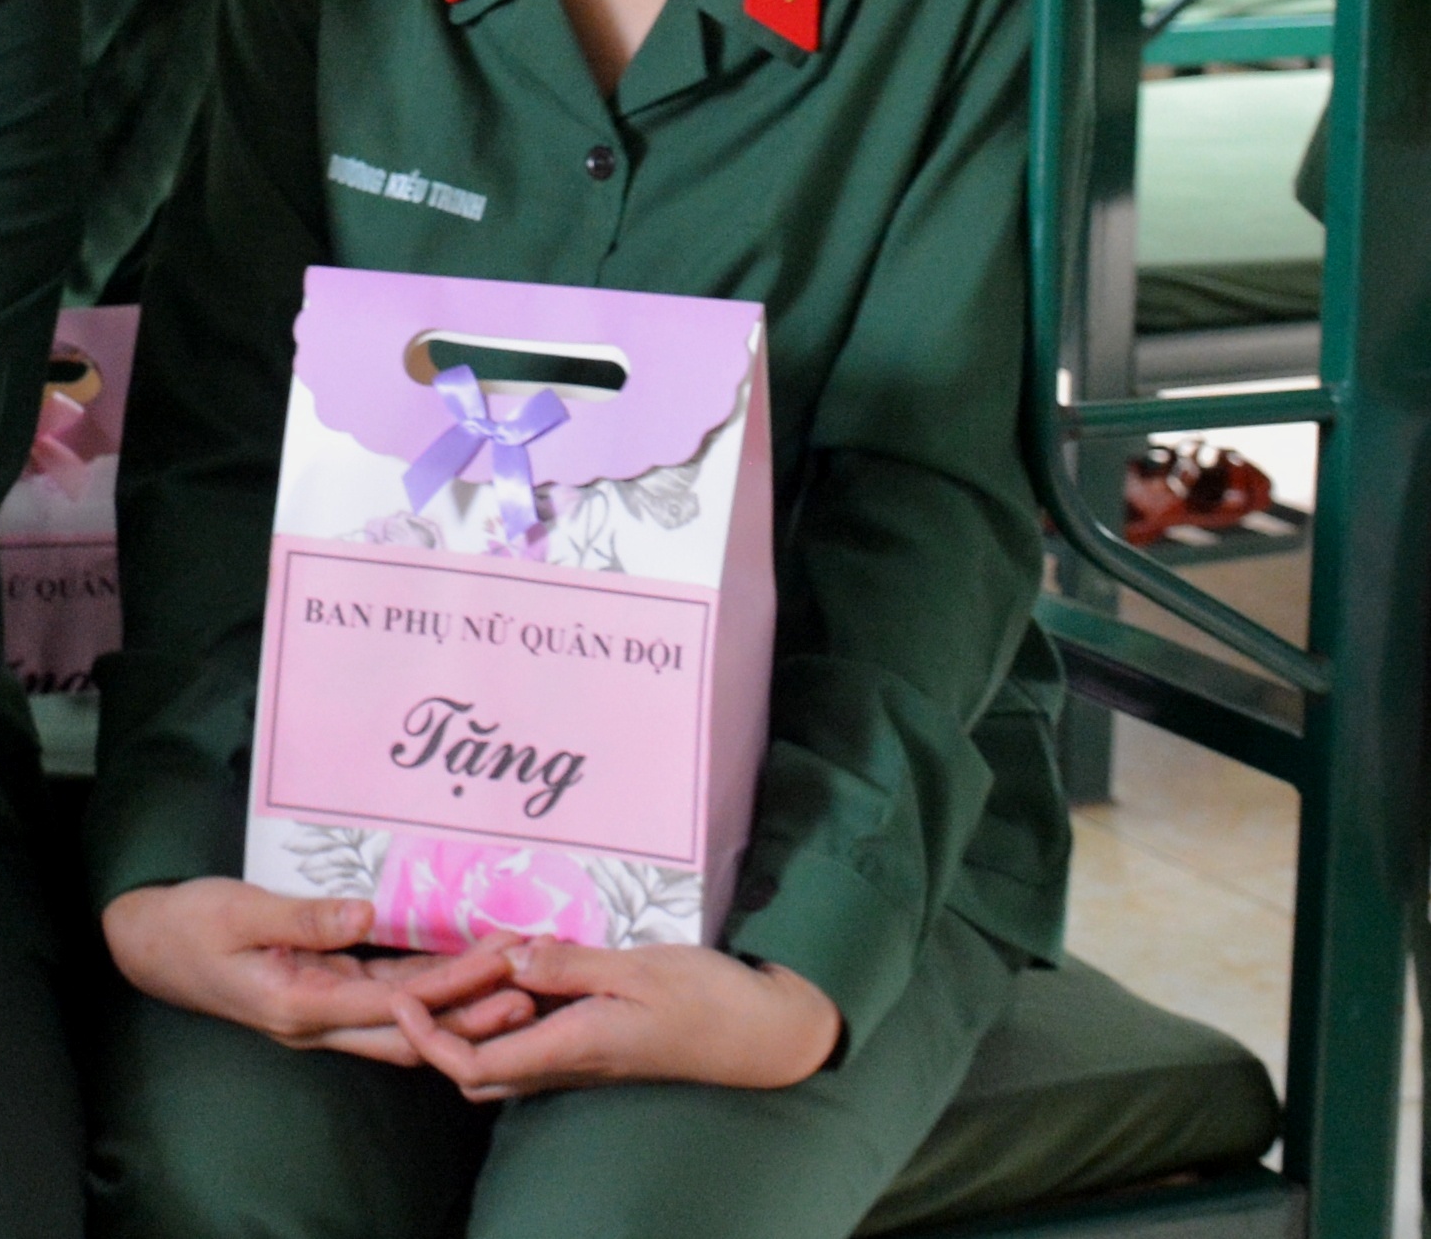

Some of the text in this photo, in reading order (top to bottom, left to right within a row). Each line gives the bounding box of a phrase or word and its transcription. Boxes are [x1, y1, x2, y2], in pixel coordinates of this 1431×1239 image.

[304, 597, 684, 674] BAN PHỤ NỮ QUÂN ĐỘI
[389, 696, 586, 819] Tặng
